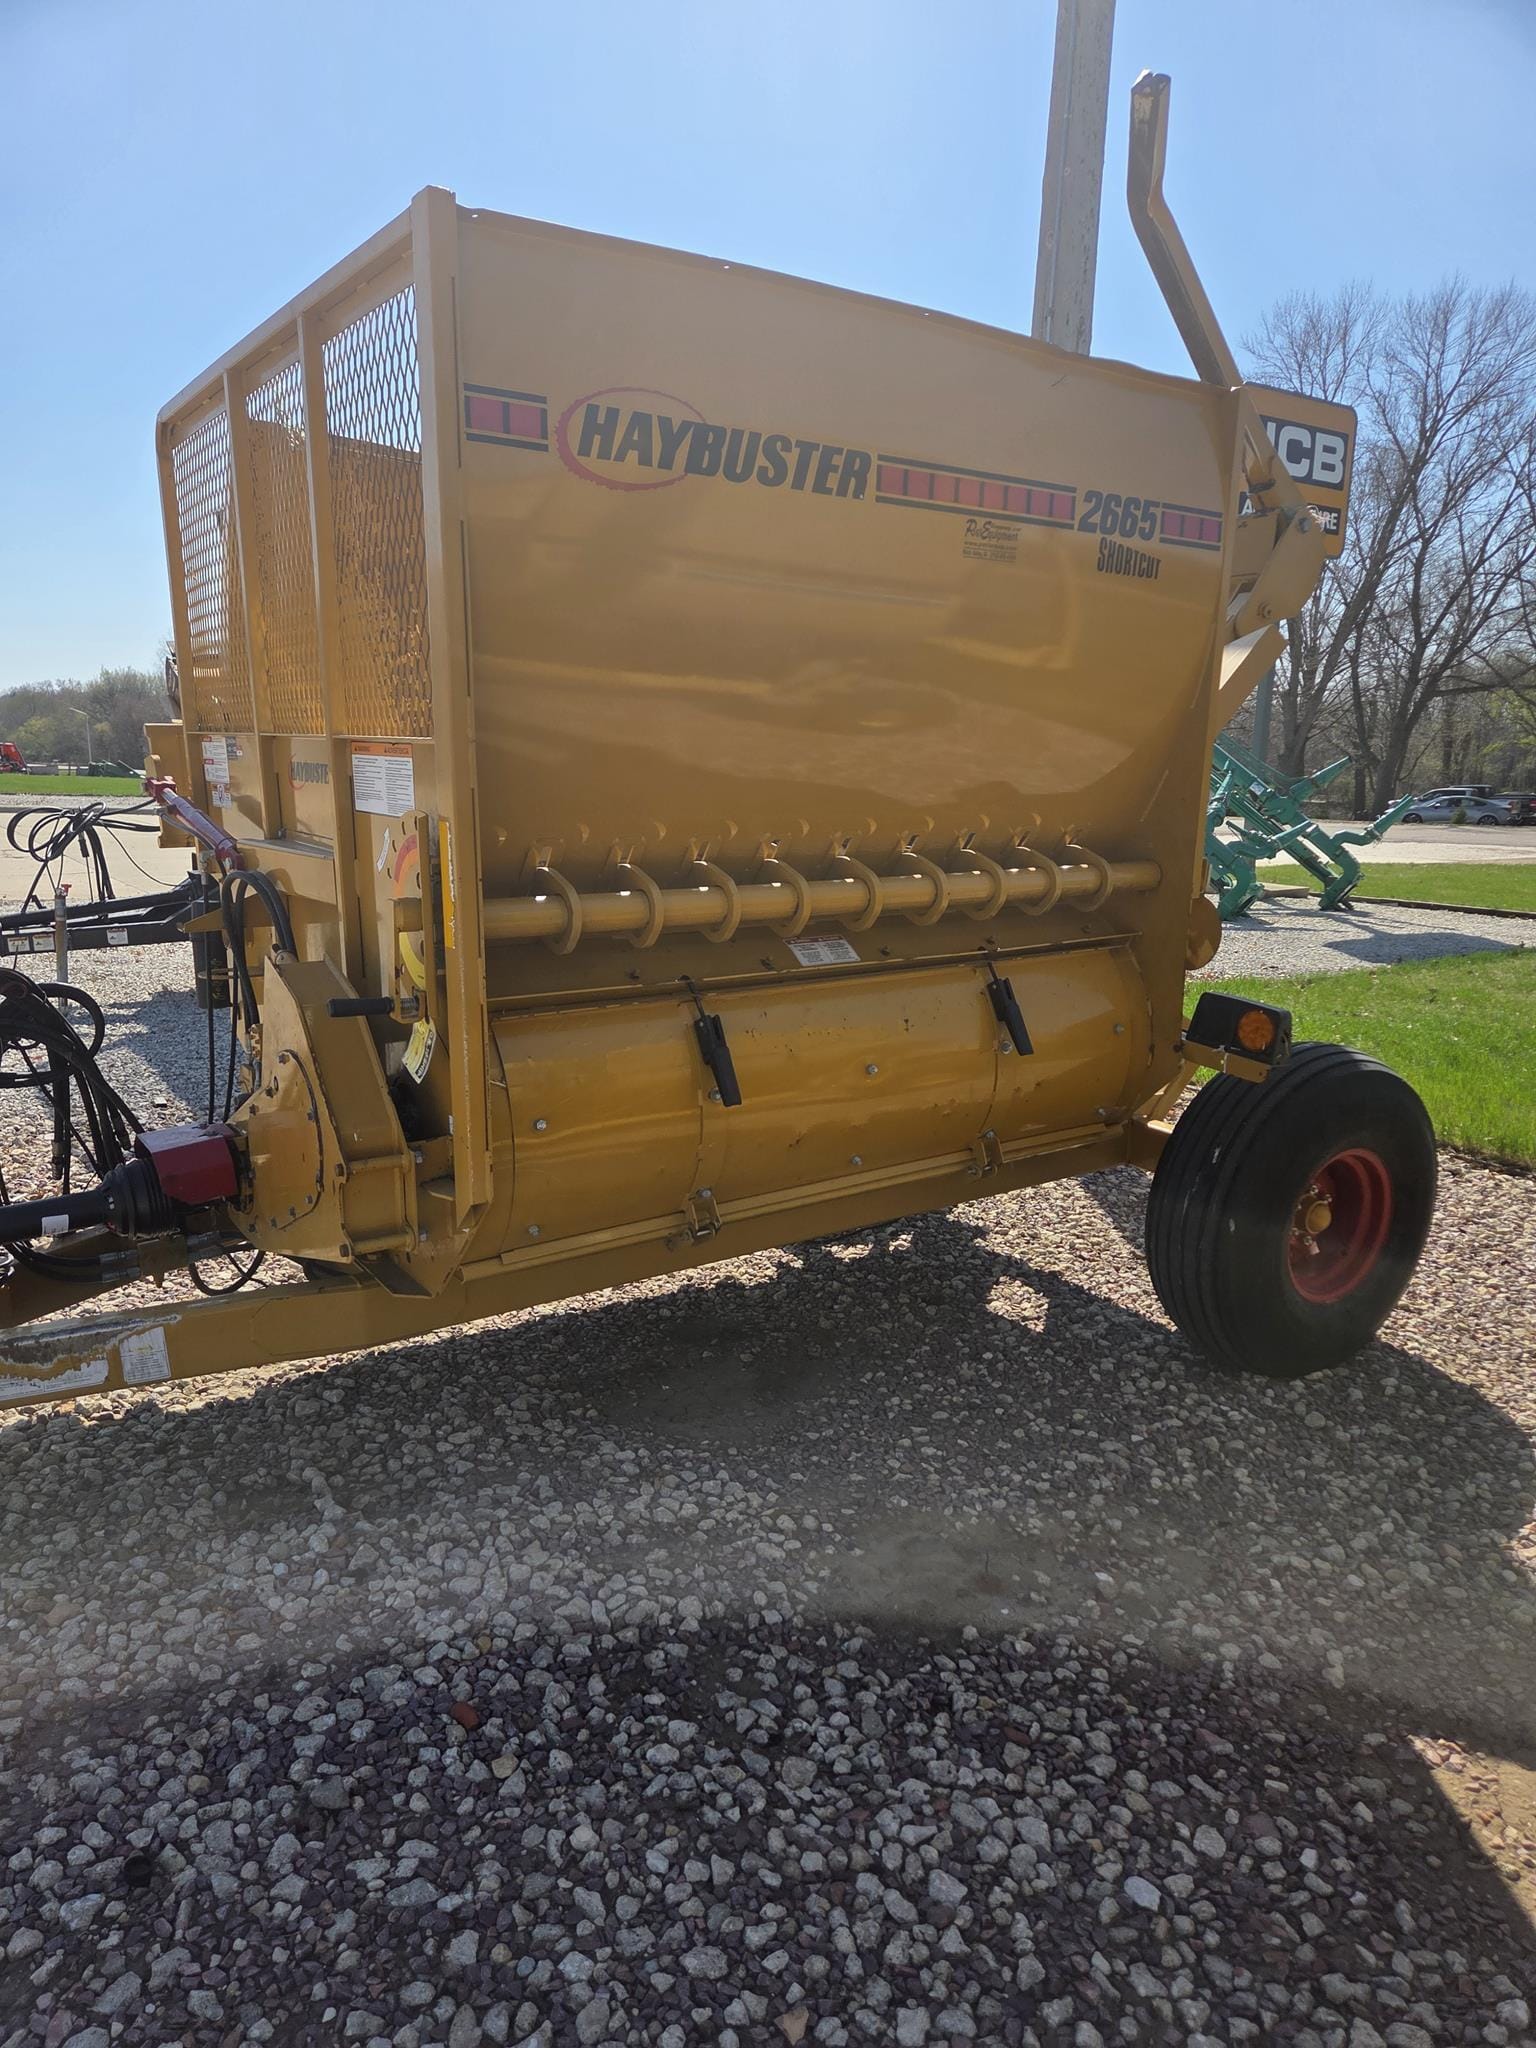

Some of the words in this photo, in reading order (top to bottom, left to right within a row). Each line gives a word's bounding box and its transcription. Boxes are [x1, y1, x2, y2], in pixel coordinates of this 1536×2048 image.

[577, 402, 872, 500] HAYBUSTER
[1077, 490, 1161, 541] 2665
[290, 760, 330, 785] HAYBUSTE
